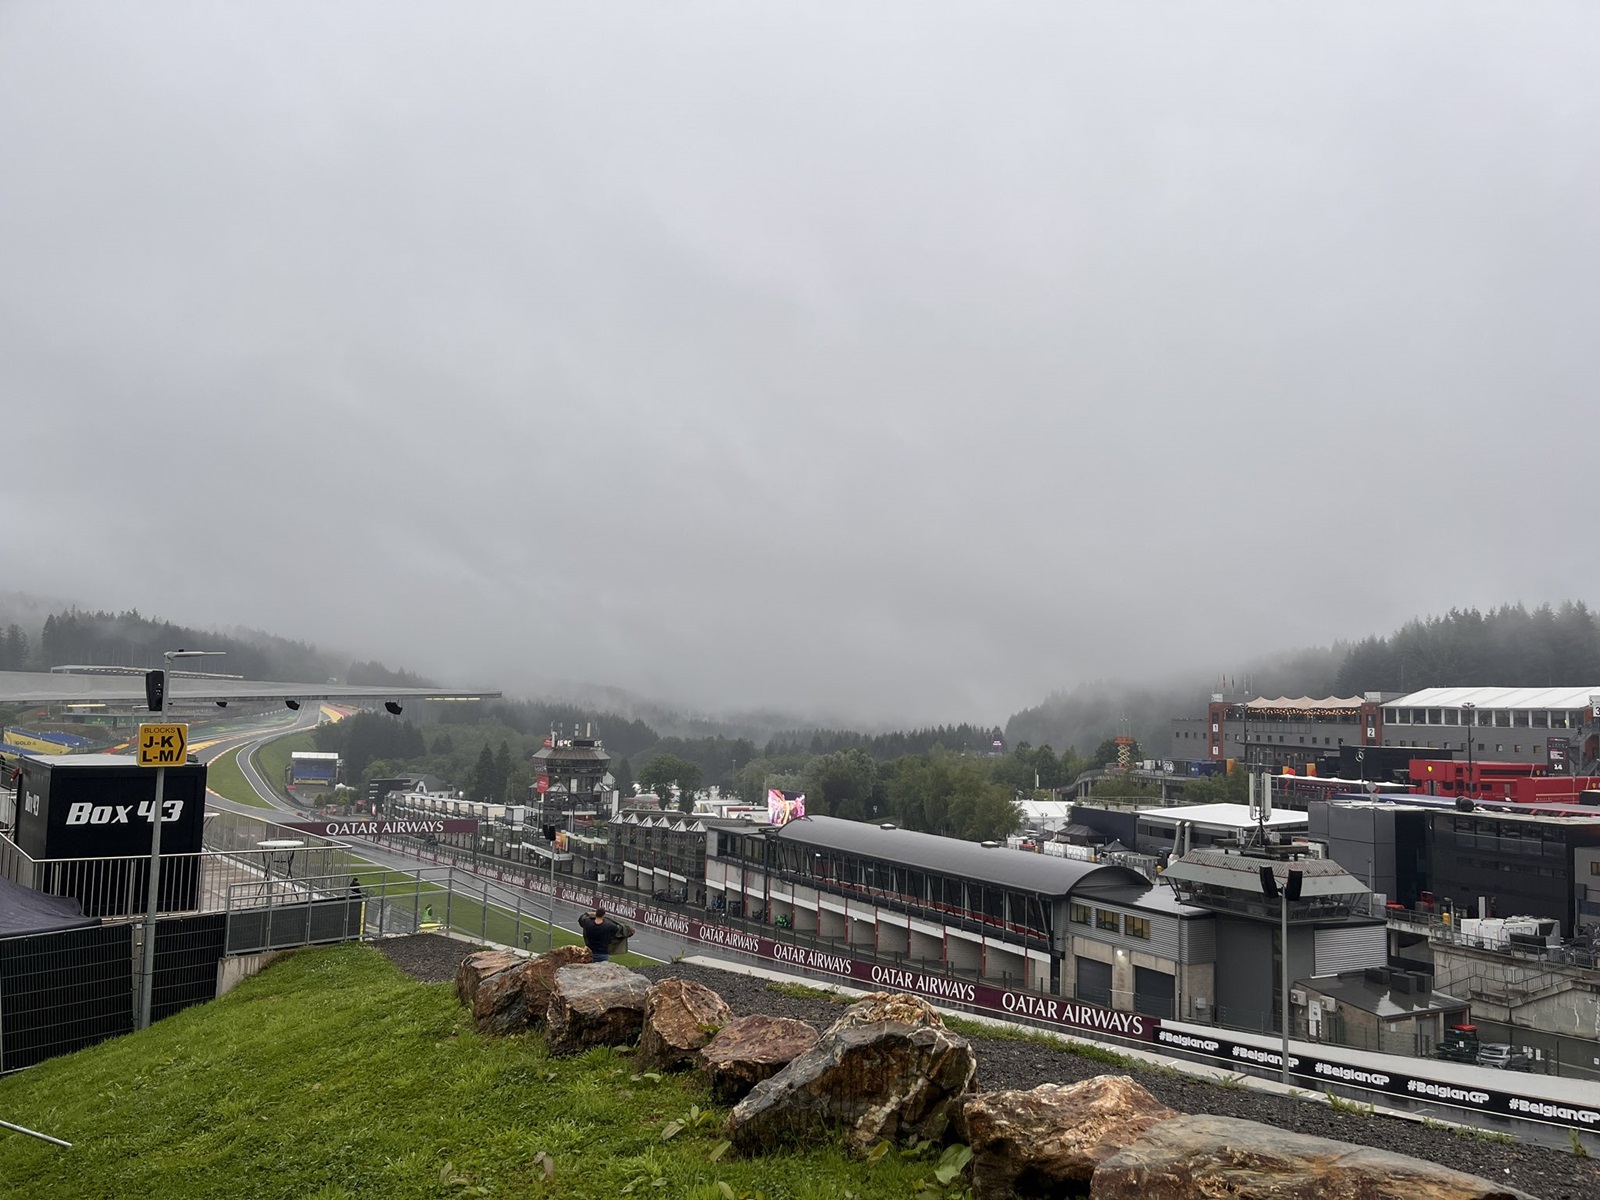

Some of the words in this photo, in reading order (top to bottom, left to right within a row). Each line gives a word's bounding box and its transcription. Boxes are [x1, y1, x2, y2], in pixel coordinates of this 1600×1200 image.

[143, 736, 174, 748] J-K
[1368, 728, 1374, 737] 2
[142, 750, 174, 763] L-M
[65, 802, 134, 825] Box
[137, 800, 184, 823] 43
[326, 822, 378, 836] QATAR
[381, 820, 444, 833] AIRWAYS
[599, 899, 616, 912] QATAR
[616, 903, 637, 918] AIRWAYS
[643, 911, 663, 926] QATAR
[663, 916, 690, 934] AIRWAYS
[699, 926, 724, 944] QATAR
[725, 932, 760, 952] AIRWAYS
[773, 943, 806, 964] QATAR
[807, 950, 852, 974] AIRWAYS
[871, 965, 914, 988] QATAR
[915, 973, 976, 1001] AIRWAYS
[1002, 992, 1057, 1020] QATAR
[1063, 1003, 1144, 1035] AIRWAYS
[1158, 1031, 1219, 1052] #BelgianGP
[1314, 1062, 1390, 1086] #BelgianGP
[1407, 1080, 1490, 1104] #BelgianGP
[1508, 1098, 1600, 1124] #BelgianGP
